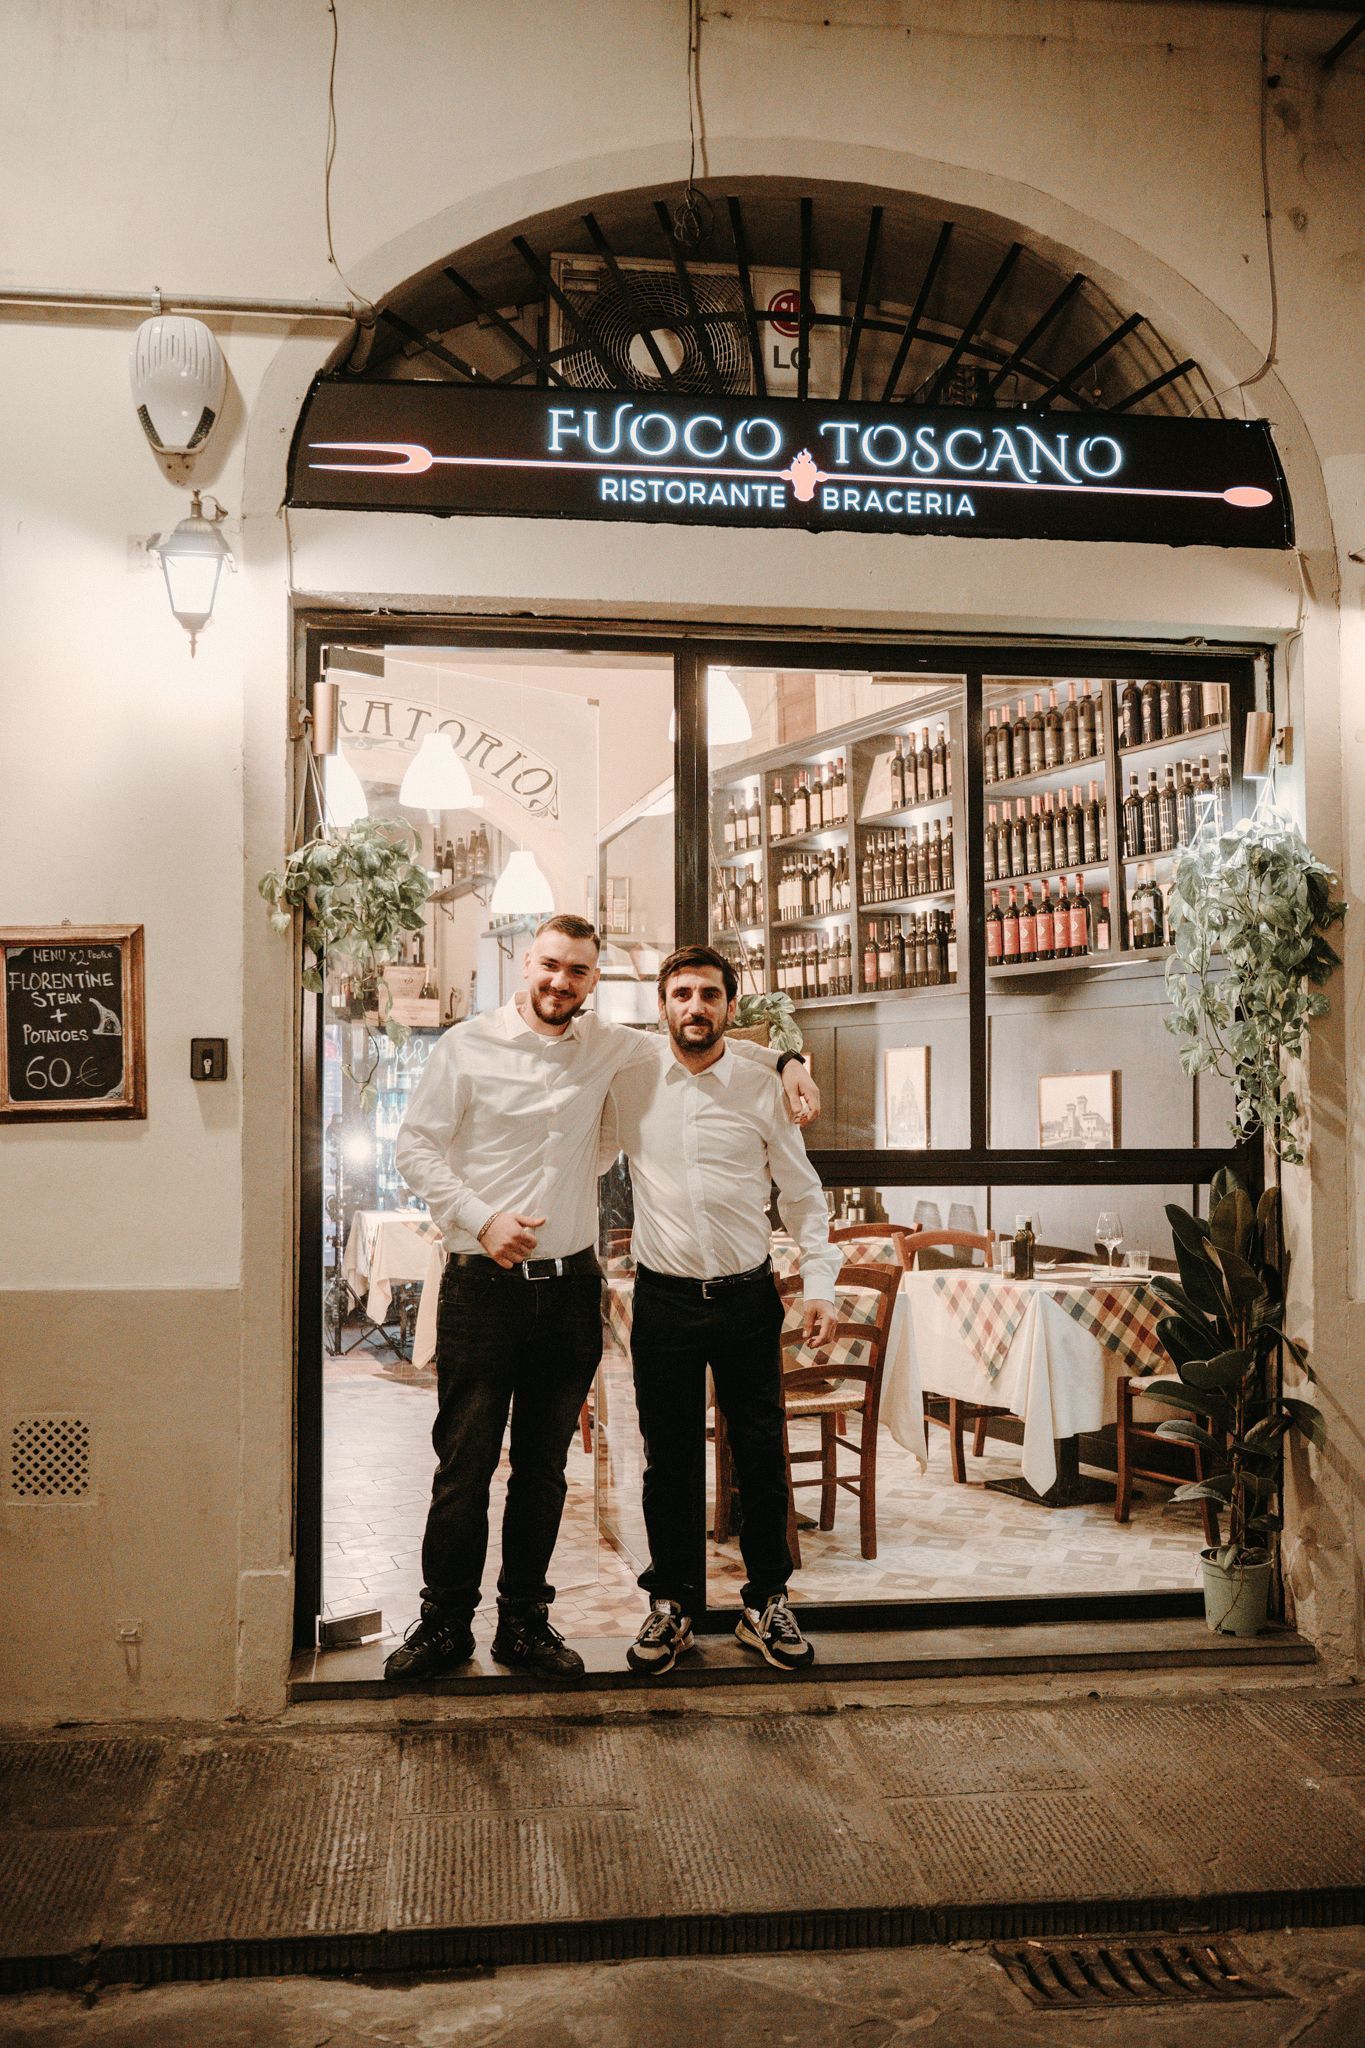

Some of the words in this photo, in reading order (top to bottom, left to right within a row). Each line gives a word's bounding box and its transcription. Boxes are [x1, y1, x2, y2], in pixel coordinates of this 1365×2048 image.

[548, 404, 783, 461] FUOCO
[820, 423, 1122, 484] TOSCANO
[600, 476, 787, 509] RISTORANTE
[823, 486, 976, 517] BRACERIA
[33, 949, 67, 964] MENU
[31, 991, 83, 1008] STEAK
